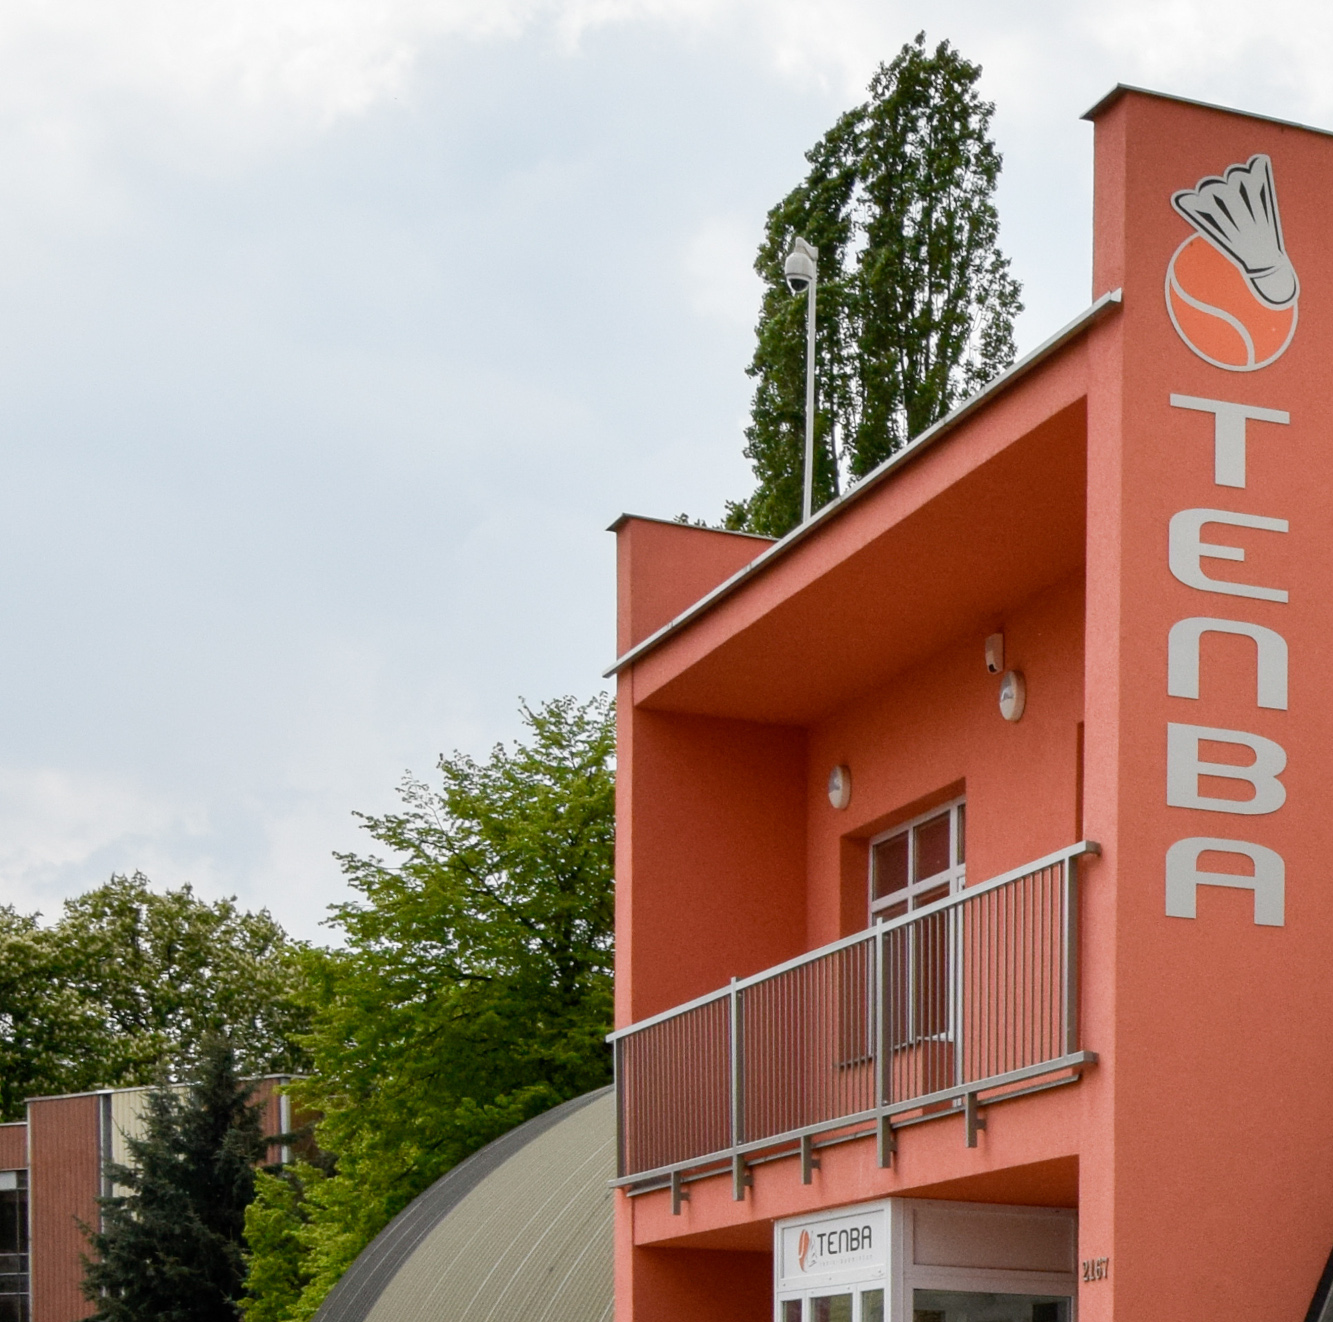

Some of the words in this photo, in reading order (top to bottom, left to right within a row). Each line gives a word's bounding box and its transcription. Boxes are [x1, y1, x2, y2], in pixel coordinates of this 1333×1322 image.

[1165, 393, 1290, 927] TENBA
[816, 1225, 872, 1257] TENBA
[1083, 1257, 1109, 1282] 2167
